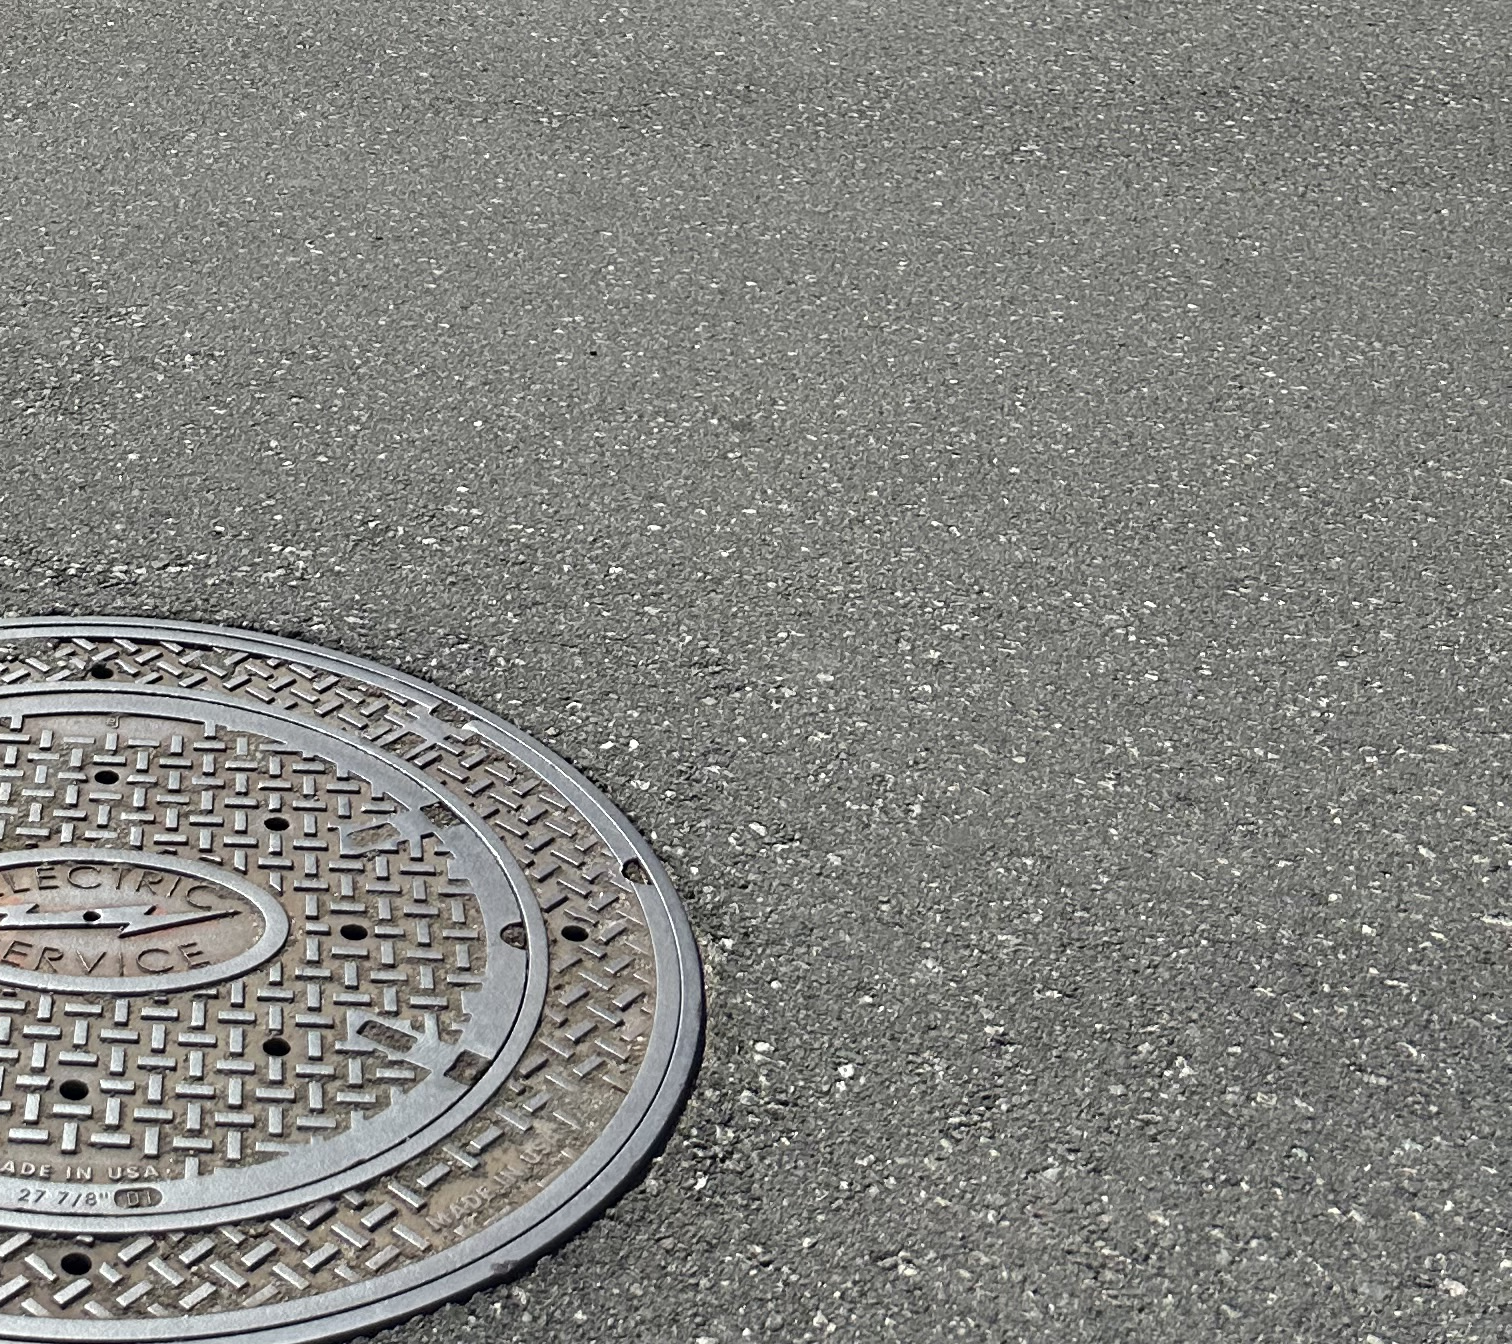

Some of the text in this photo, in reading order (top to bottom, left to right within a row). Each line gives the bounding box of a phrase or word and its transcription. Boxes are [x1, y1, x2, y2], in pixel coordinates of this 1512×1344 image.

[65, 1166, 93, 1181] IN
[108, 1164, 160, 1181] USA
[18, 1187, 47, 1204] 27
[425, 1185, 497, 1231] MADE
